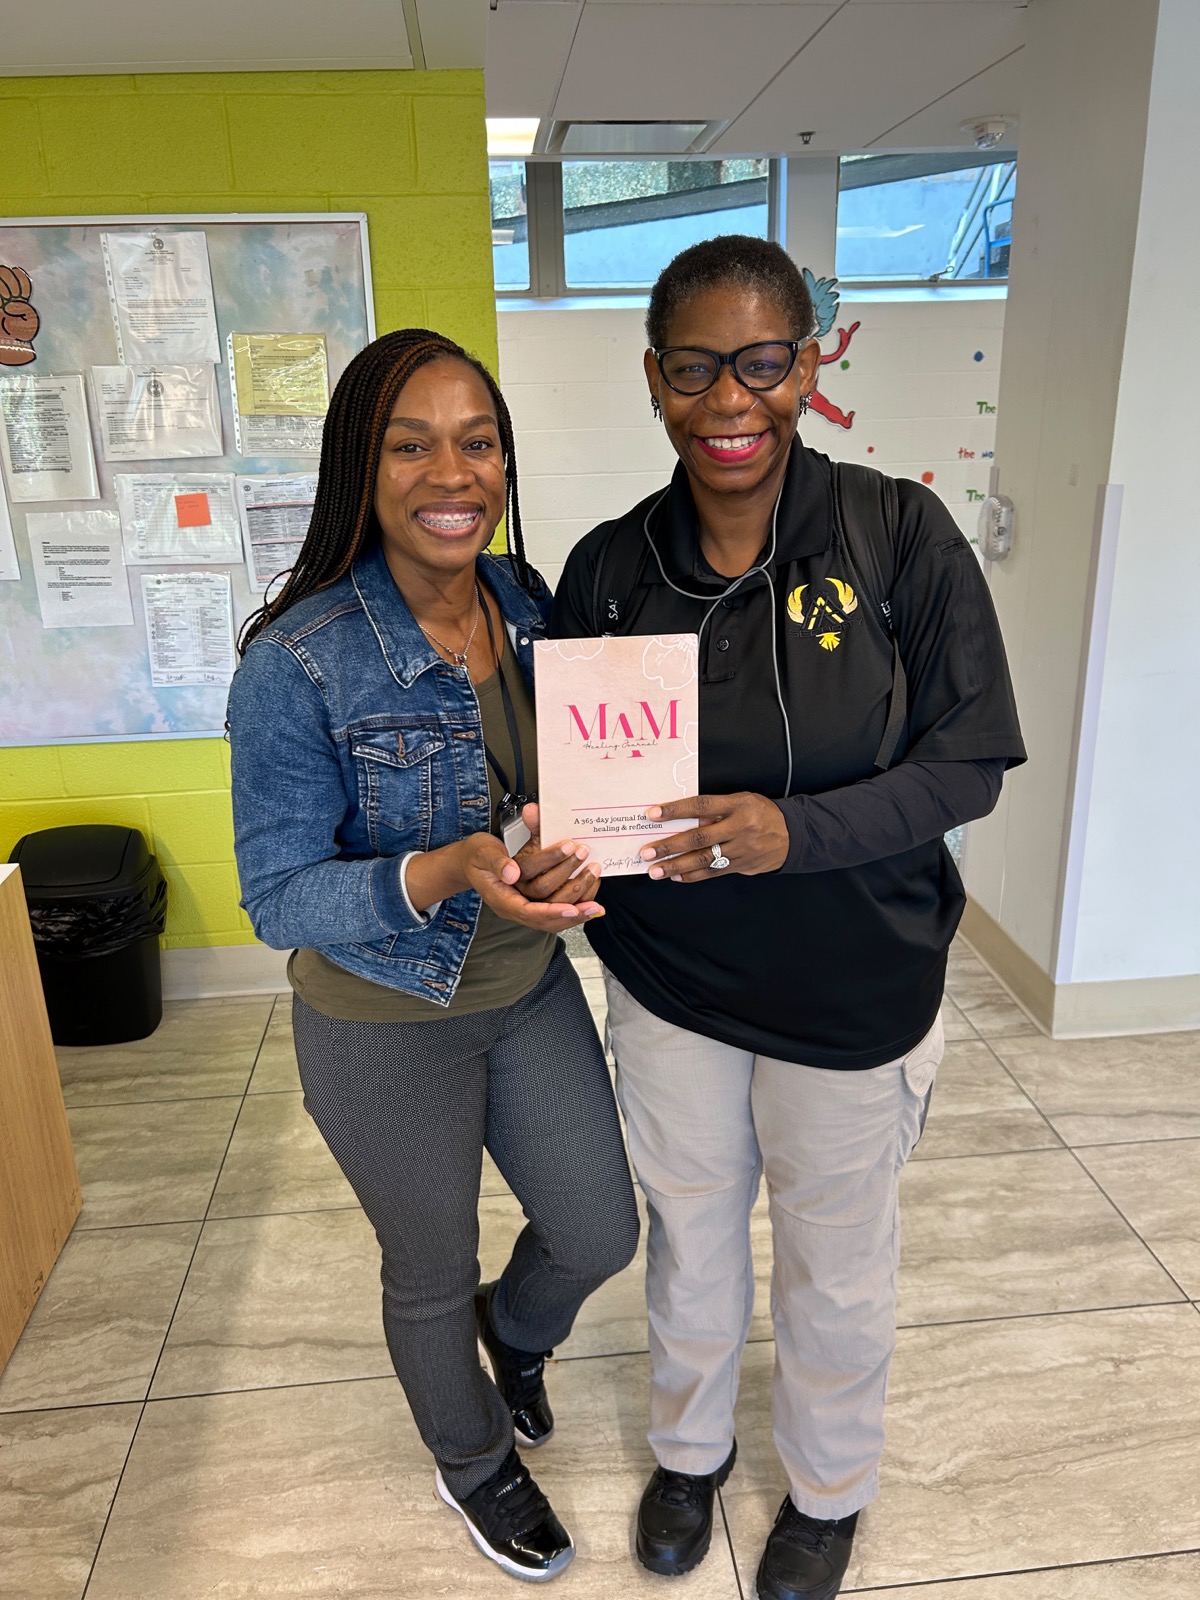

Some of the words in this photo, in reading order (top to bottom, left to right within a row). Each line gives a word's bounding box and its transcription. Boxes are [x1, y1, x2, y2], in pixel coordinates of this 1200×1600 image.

[976, 401, 996, 415] The
[957, 446, 975, 459] the
[966, 489, 986, 502] The
[583, 741, 620, 750] Healing
[621, 739, 658, 749] Journal
[581, 816, 608, 825] 365-day
[610, 815, 636, 824] journal
